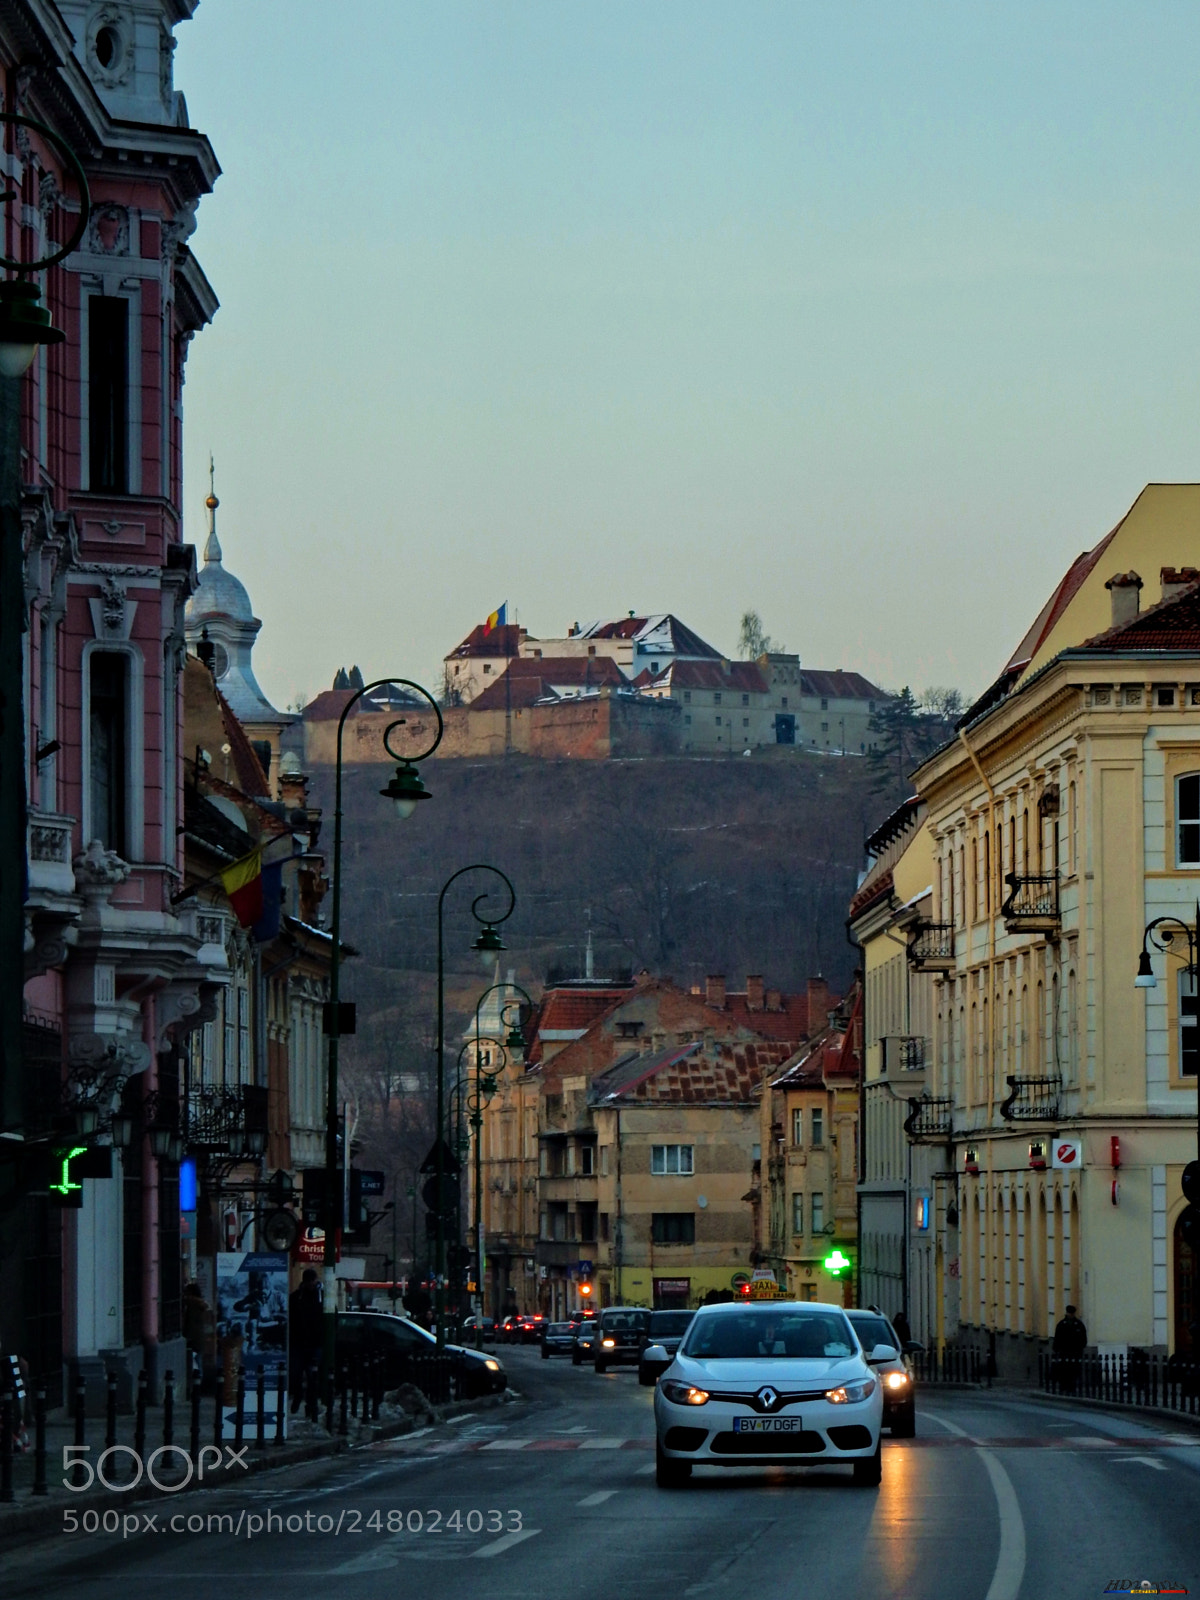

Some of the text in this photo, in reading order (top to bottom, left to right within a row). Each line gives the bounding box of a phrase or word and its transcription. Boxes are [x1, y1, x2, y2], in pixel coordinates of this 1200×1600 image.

[299, 1244, 338, 1253] Christ
[741, 1419, 799, 1431] BV 17 DGF
